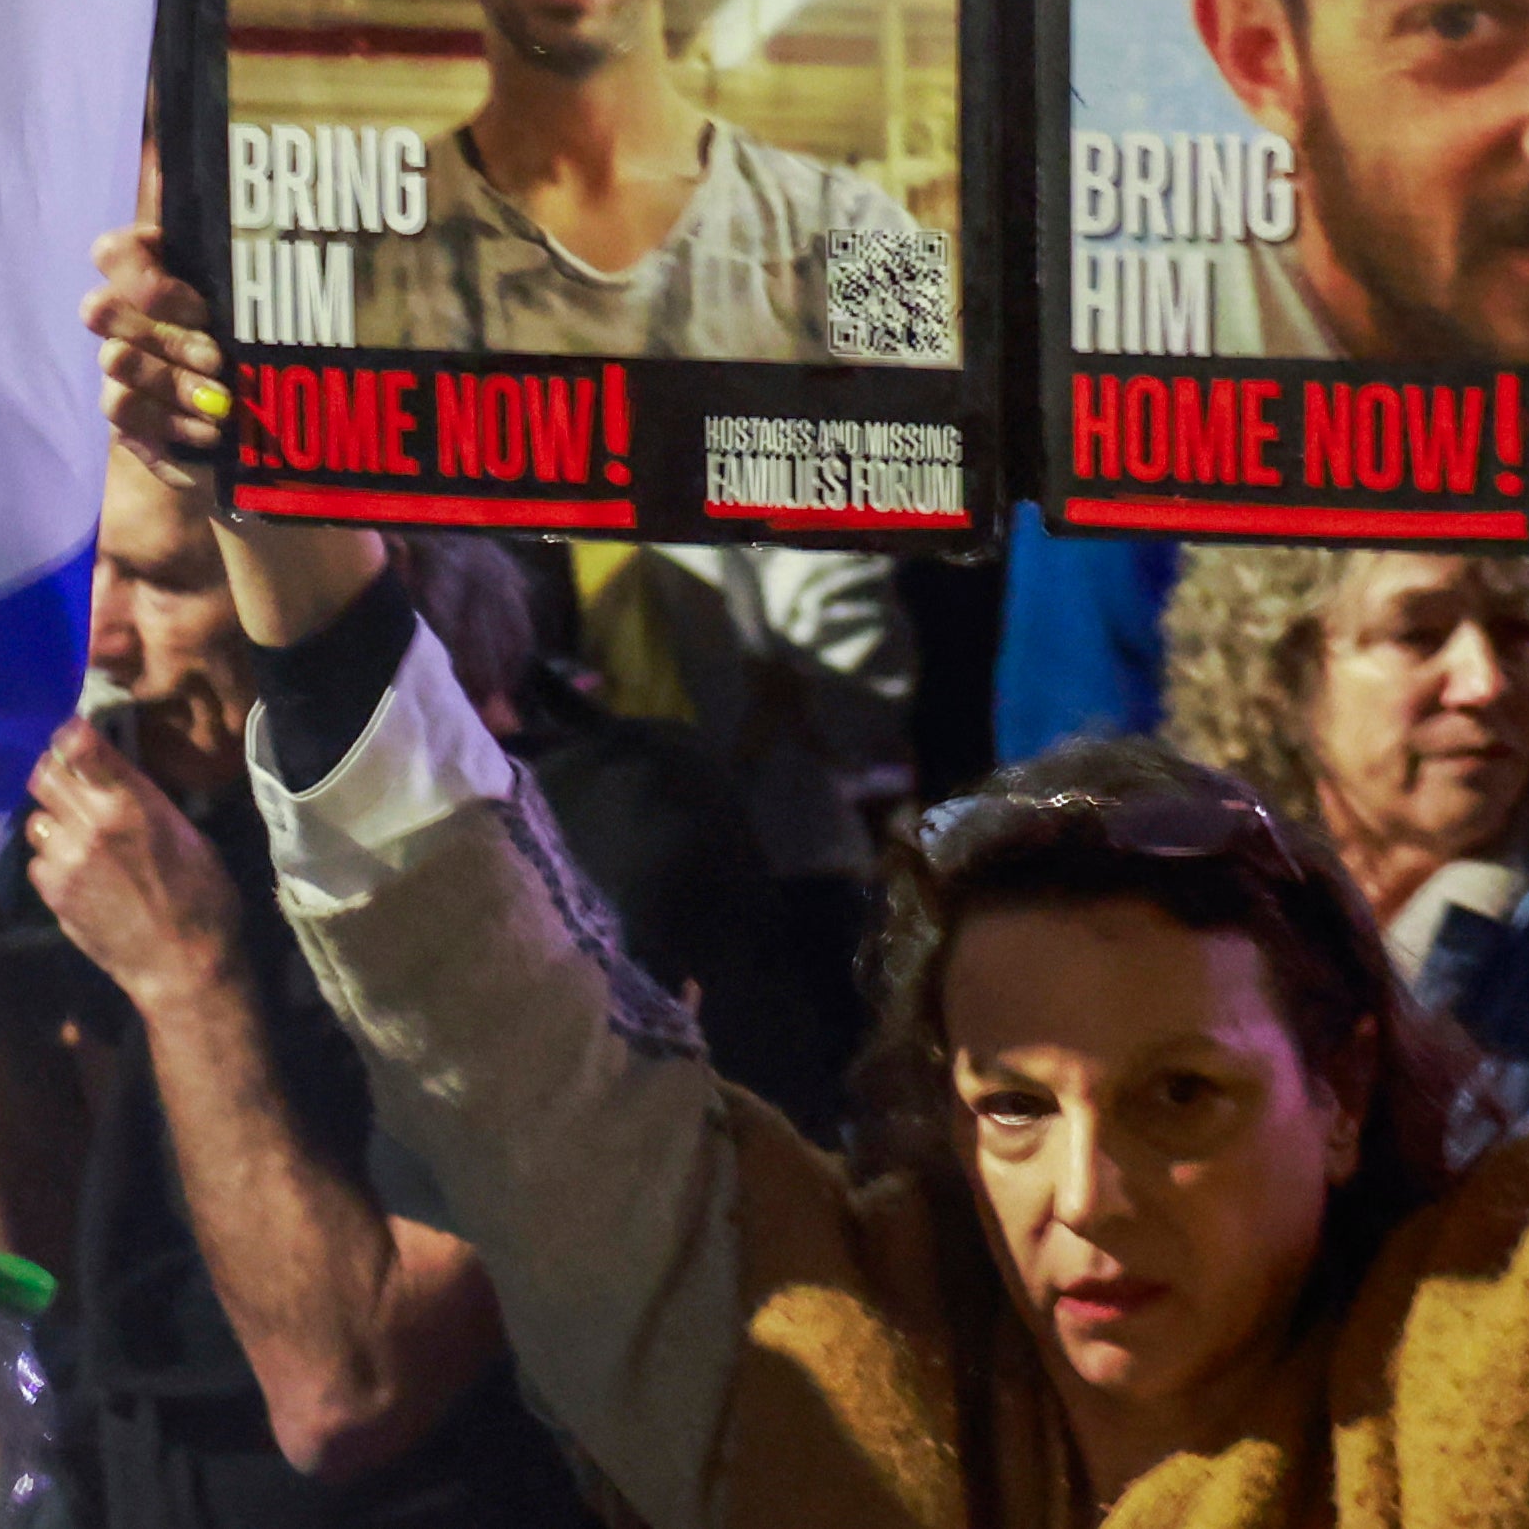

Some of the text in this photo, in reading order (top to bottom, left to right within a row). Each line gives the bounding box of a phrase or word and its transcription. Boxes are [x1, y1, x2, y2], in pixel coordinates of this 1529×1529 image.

[228, 123, 428, 235] BRING
[1072, 131, 1296, 242] BRING
[231, 239, 357, 348] HIM
[1073, 247, 1213, 358] HIM
[239, 363, 632, 486] HOME NOW!
[705, 416, 964, 463] HOSTAGES AND MISSING
[1072, 373, 1524, 496] HOME NOW!
[706, 452, 965, 516] FAMILIES FORUM
